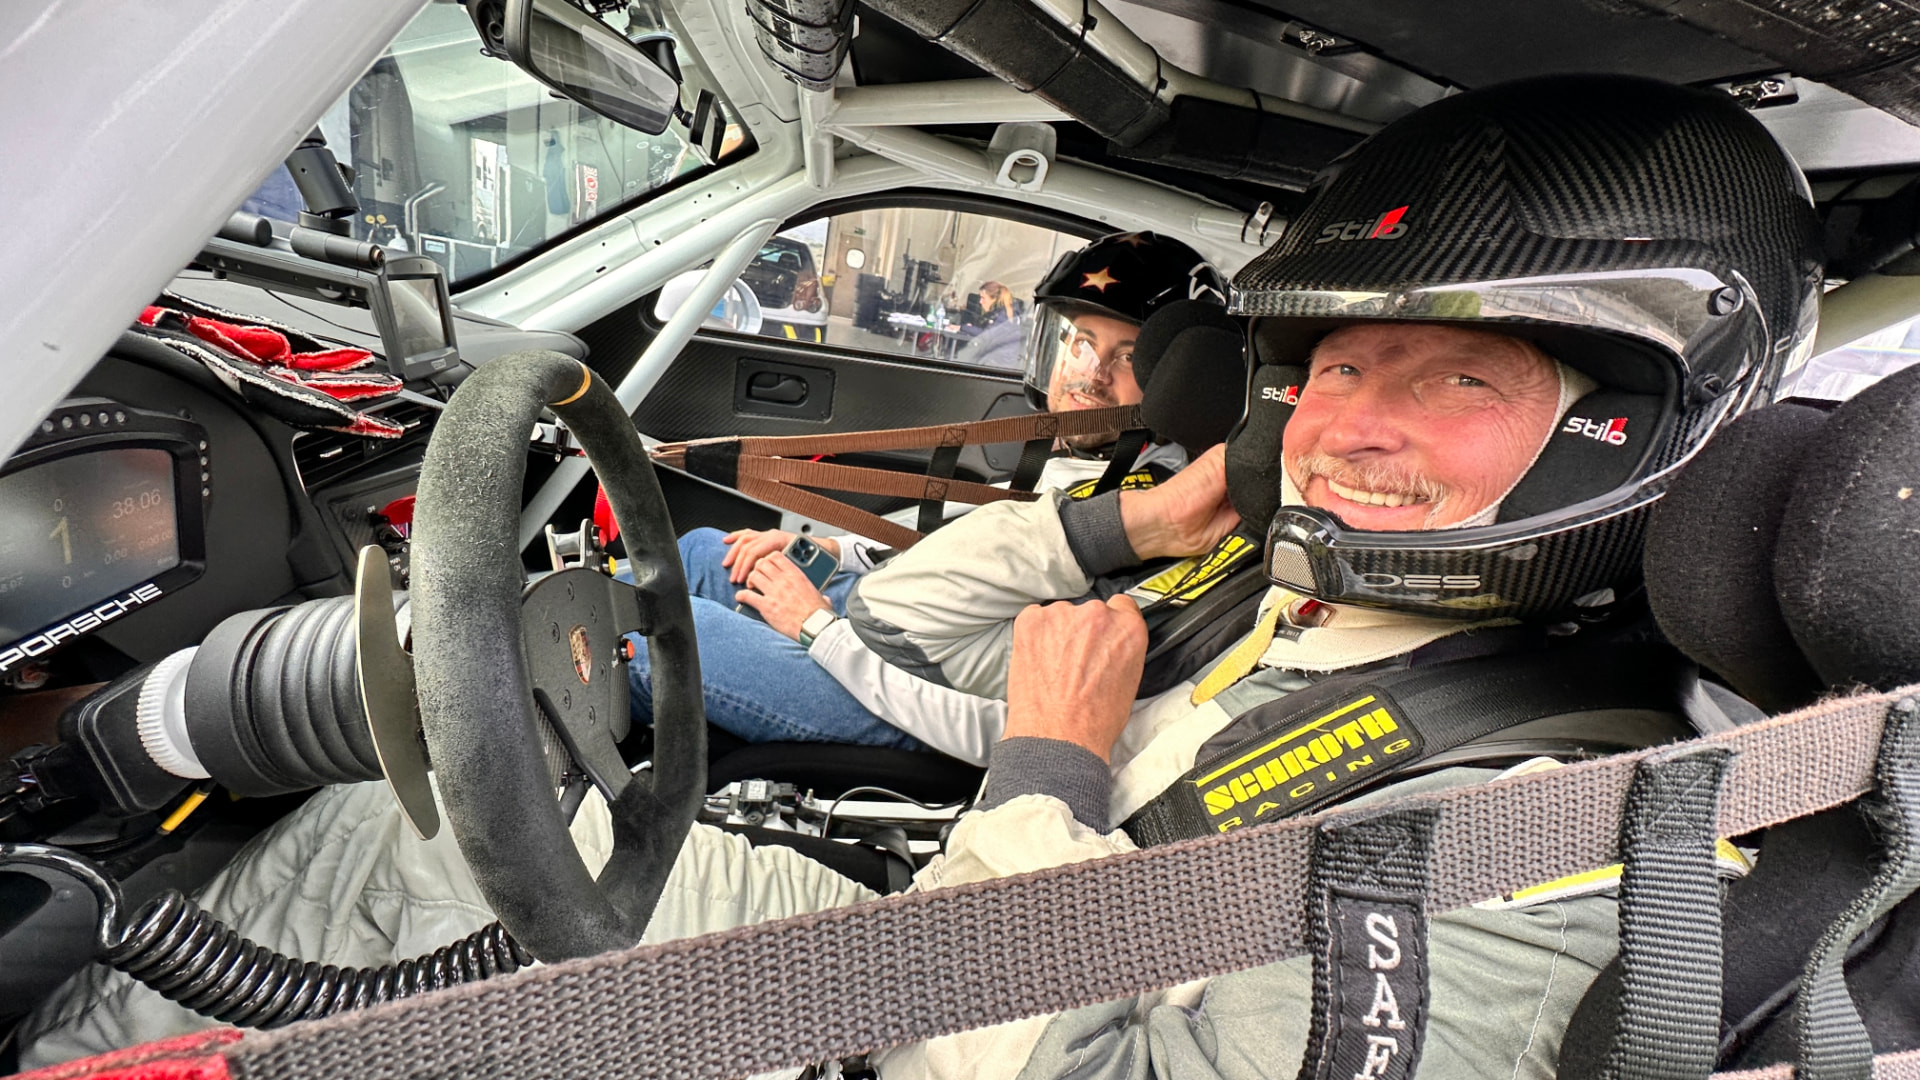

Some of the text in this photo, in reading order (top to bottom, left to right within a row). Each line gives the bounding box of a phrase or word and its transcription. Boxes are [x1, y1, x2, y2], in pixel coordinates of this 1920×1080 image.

[54, 498, 63, 512] 0
[50, 516, 73, 564] 1
[62, 575, 72, 588] 0
[0, 582, 163, 672] PORSCHE
[1203, 707, 1399, 816] SCHROTH
[1217, 738, 1411, 834] RACING
